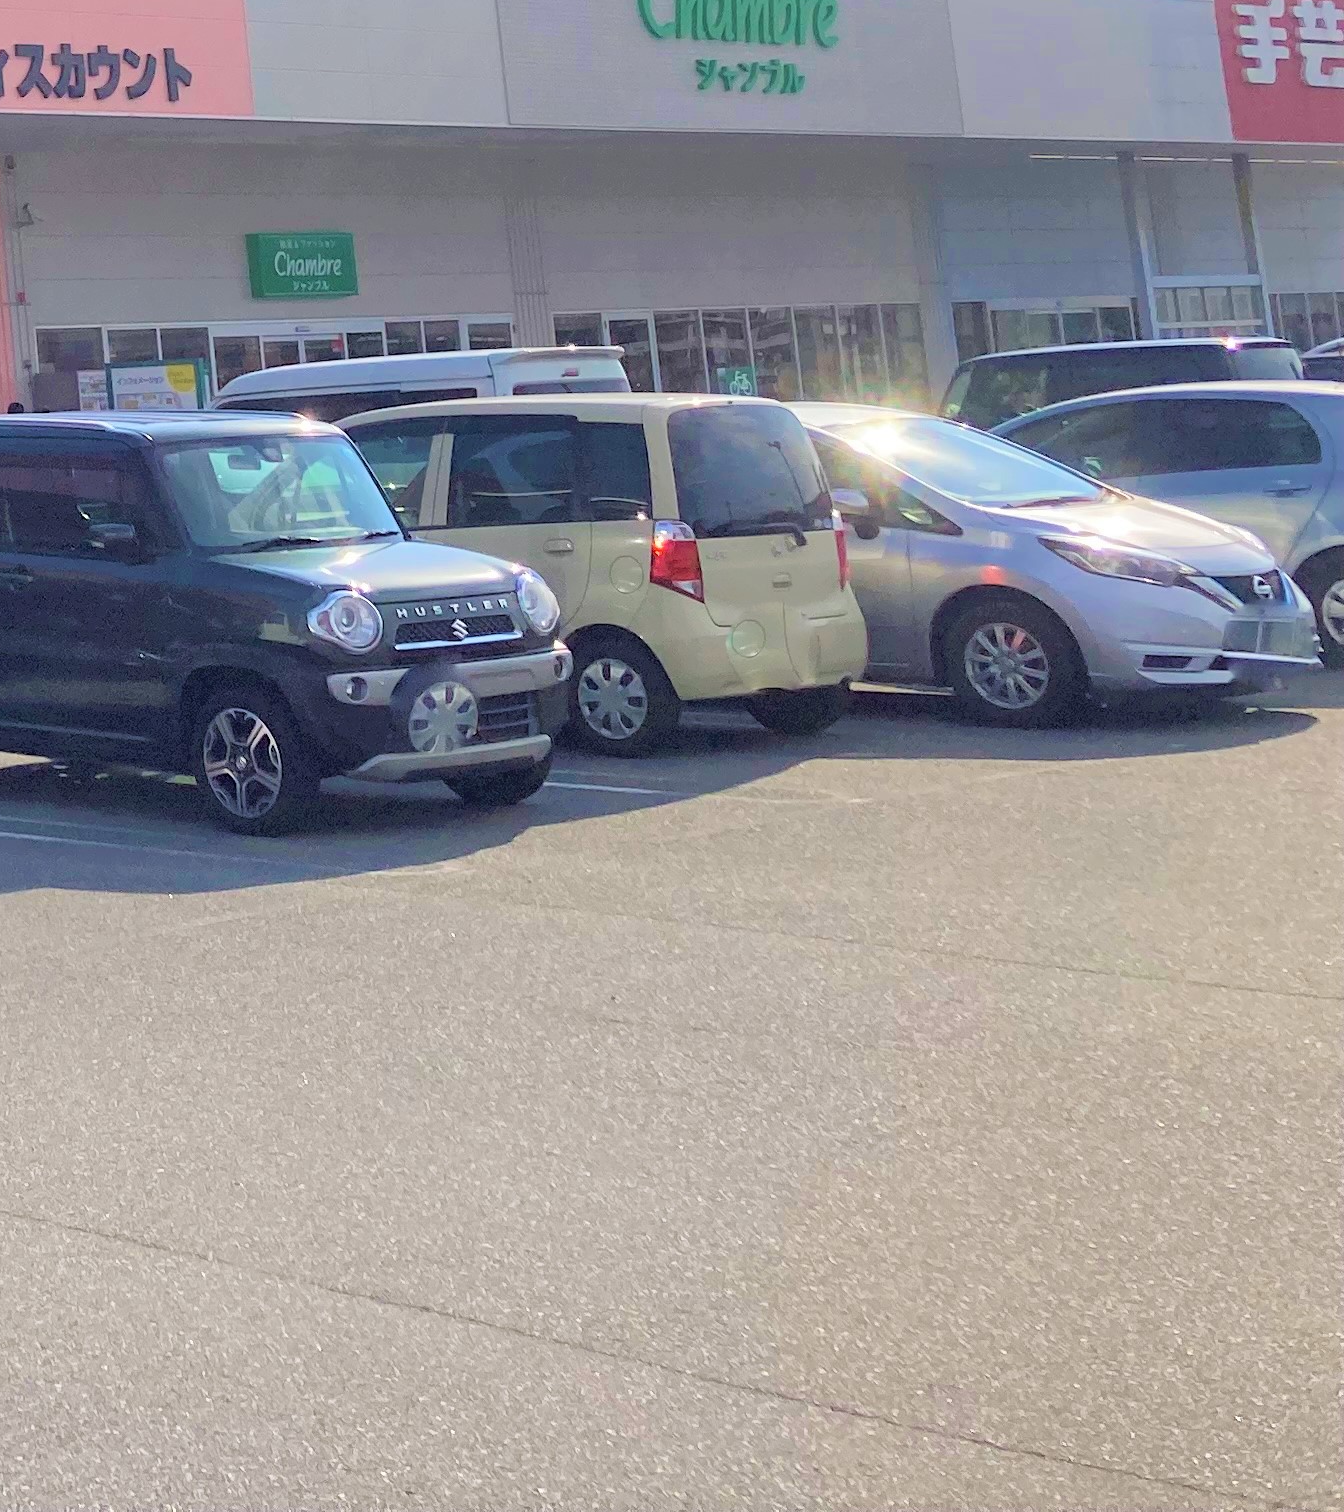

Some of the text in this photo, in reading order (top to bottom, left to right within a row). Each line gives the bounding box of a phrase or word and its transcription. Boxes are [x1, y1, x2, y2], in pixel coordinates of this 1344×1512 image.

[695, 58, 806, 95] シャンブル
[274, 251, 343, 276] Chambre
[396, 598, 509, 619] HUSTLER
